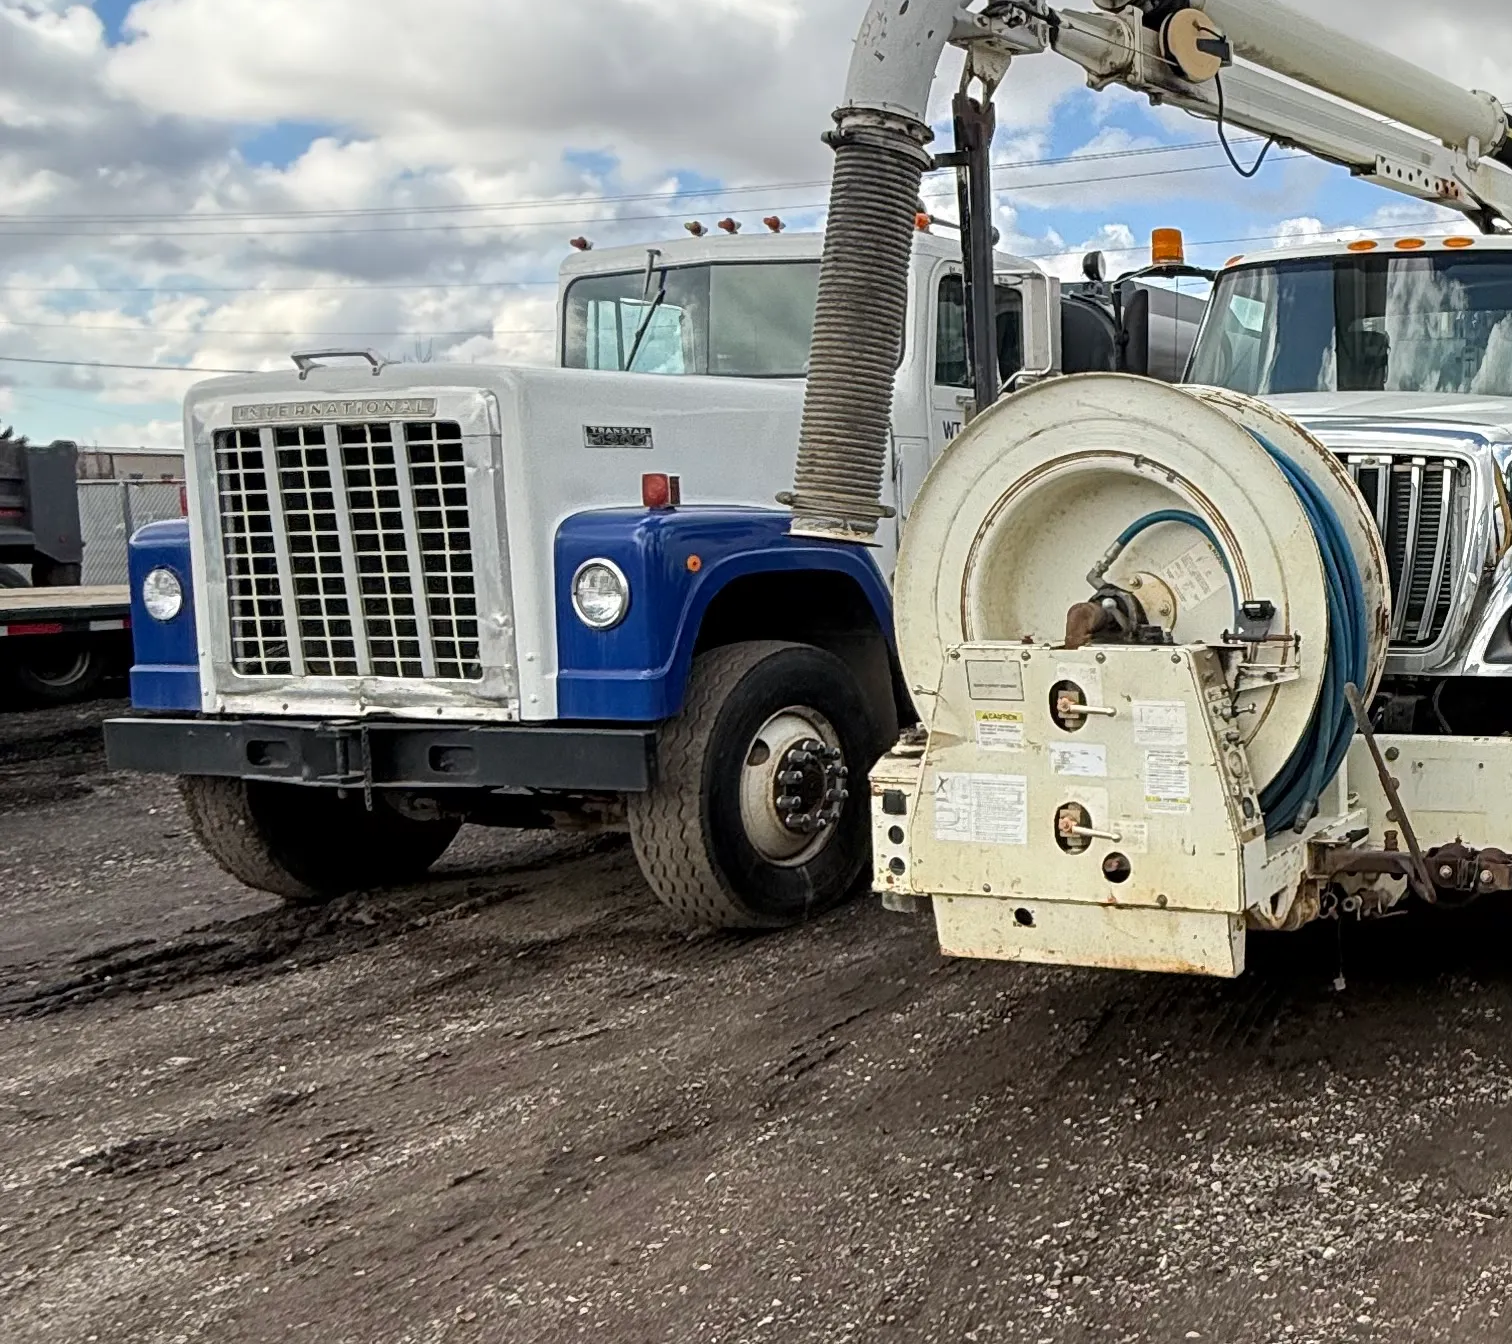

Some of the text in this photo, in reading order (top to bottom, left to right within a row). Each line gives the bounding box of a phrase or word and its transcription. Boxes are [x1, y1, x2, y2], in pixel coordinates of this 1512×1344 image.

[238, 399, 428, 420] INTERNATIONAL
[590, 426, 647, 434] TRANSTAR
[987, 712, 1018, 721] CAUTION
